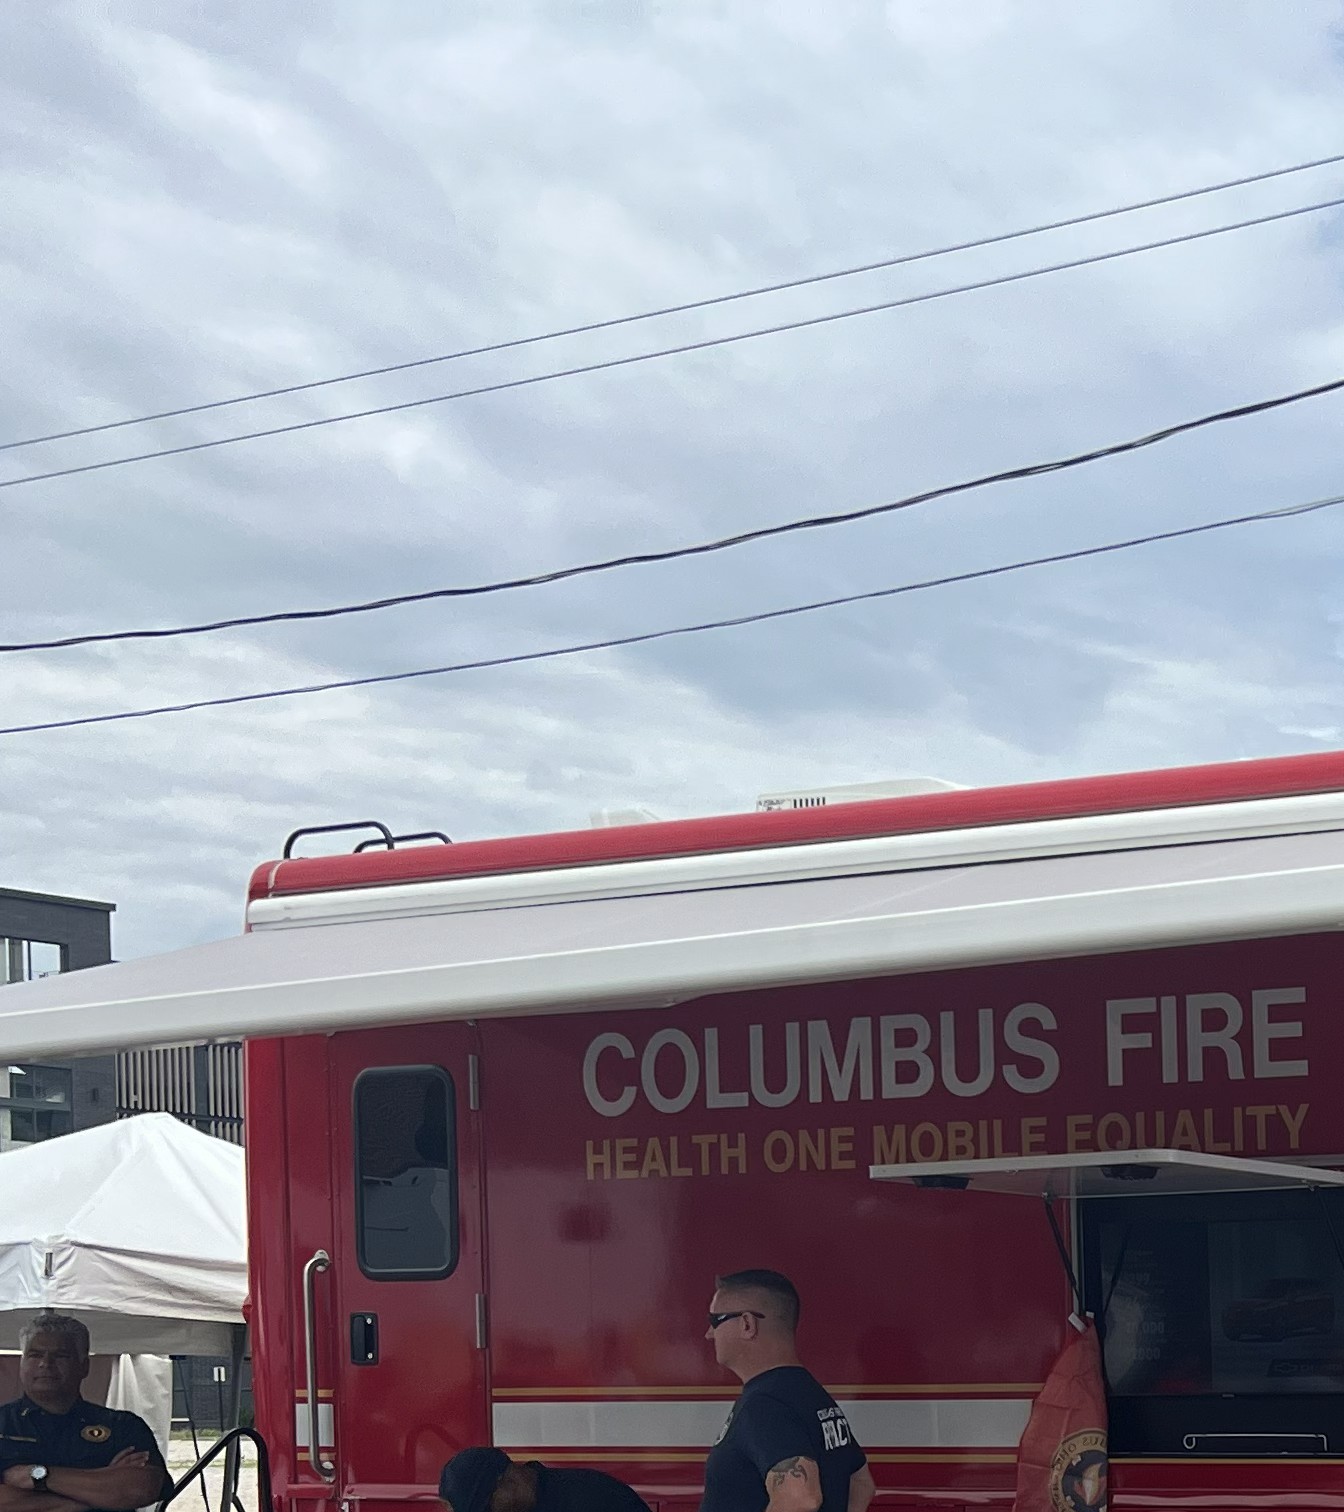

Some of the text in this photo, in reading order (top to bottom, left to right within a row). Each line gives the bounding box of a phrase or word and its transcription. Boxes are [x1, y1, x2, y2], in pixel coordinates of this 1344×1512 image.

[583, 987, 1310, 1117] COLUMBUS FIRE
[585, 1104, 1310, 1180] HEALTH ONE MOBILE EQUALITY
